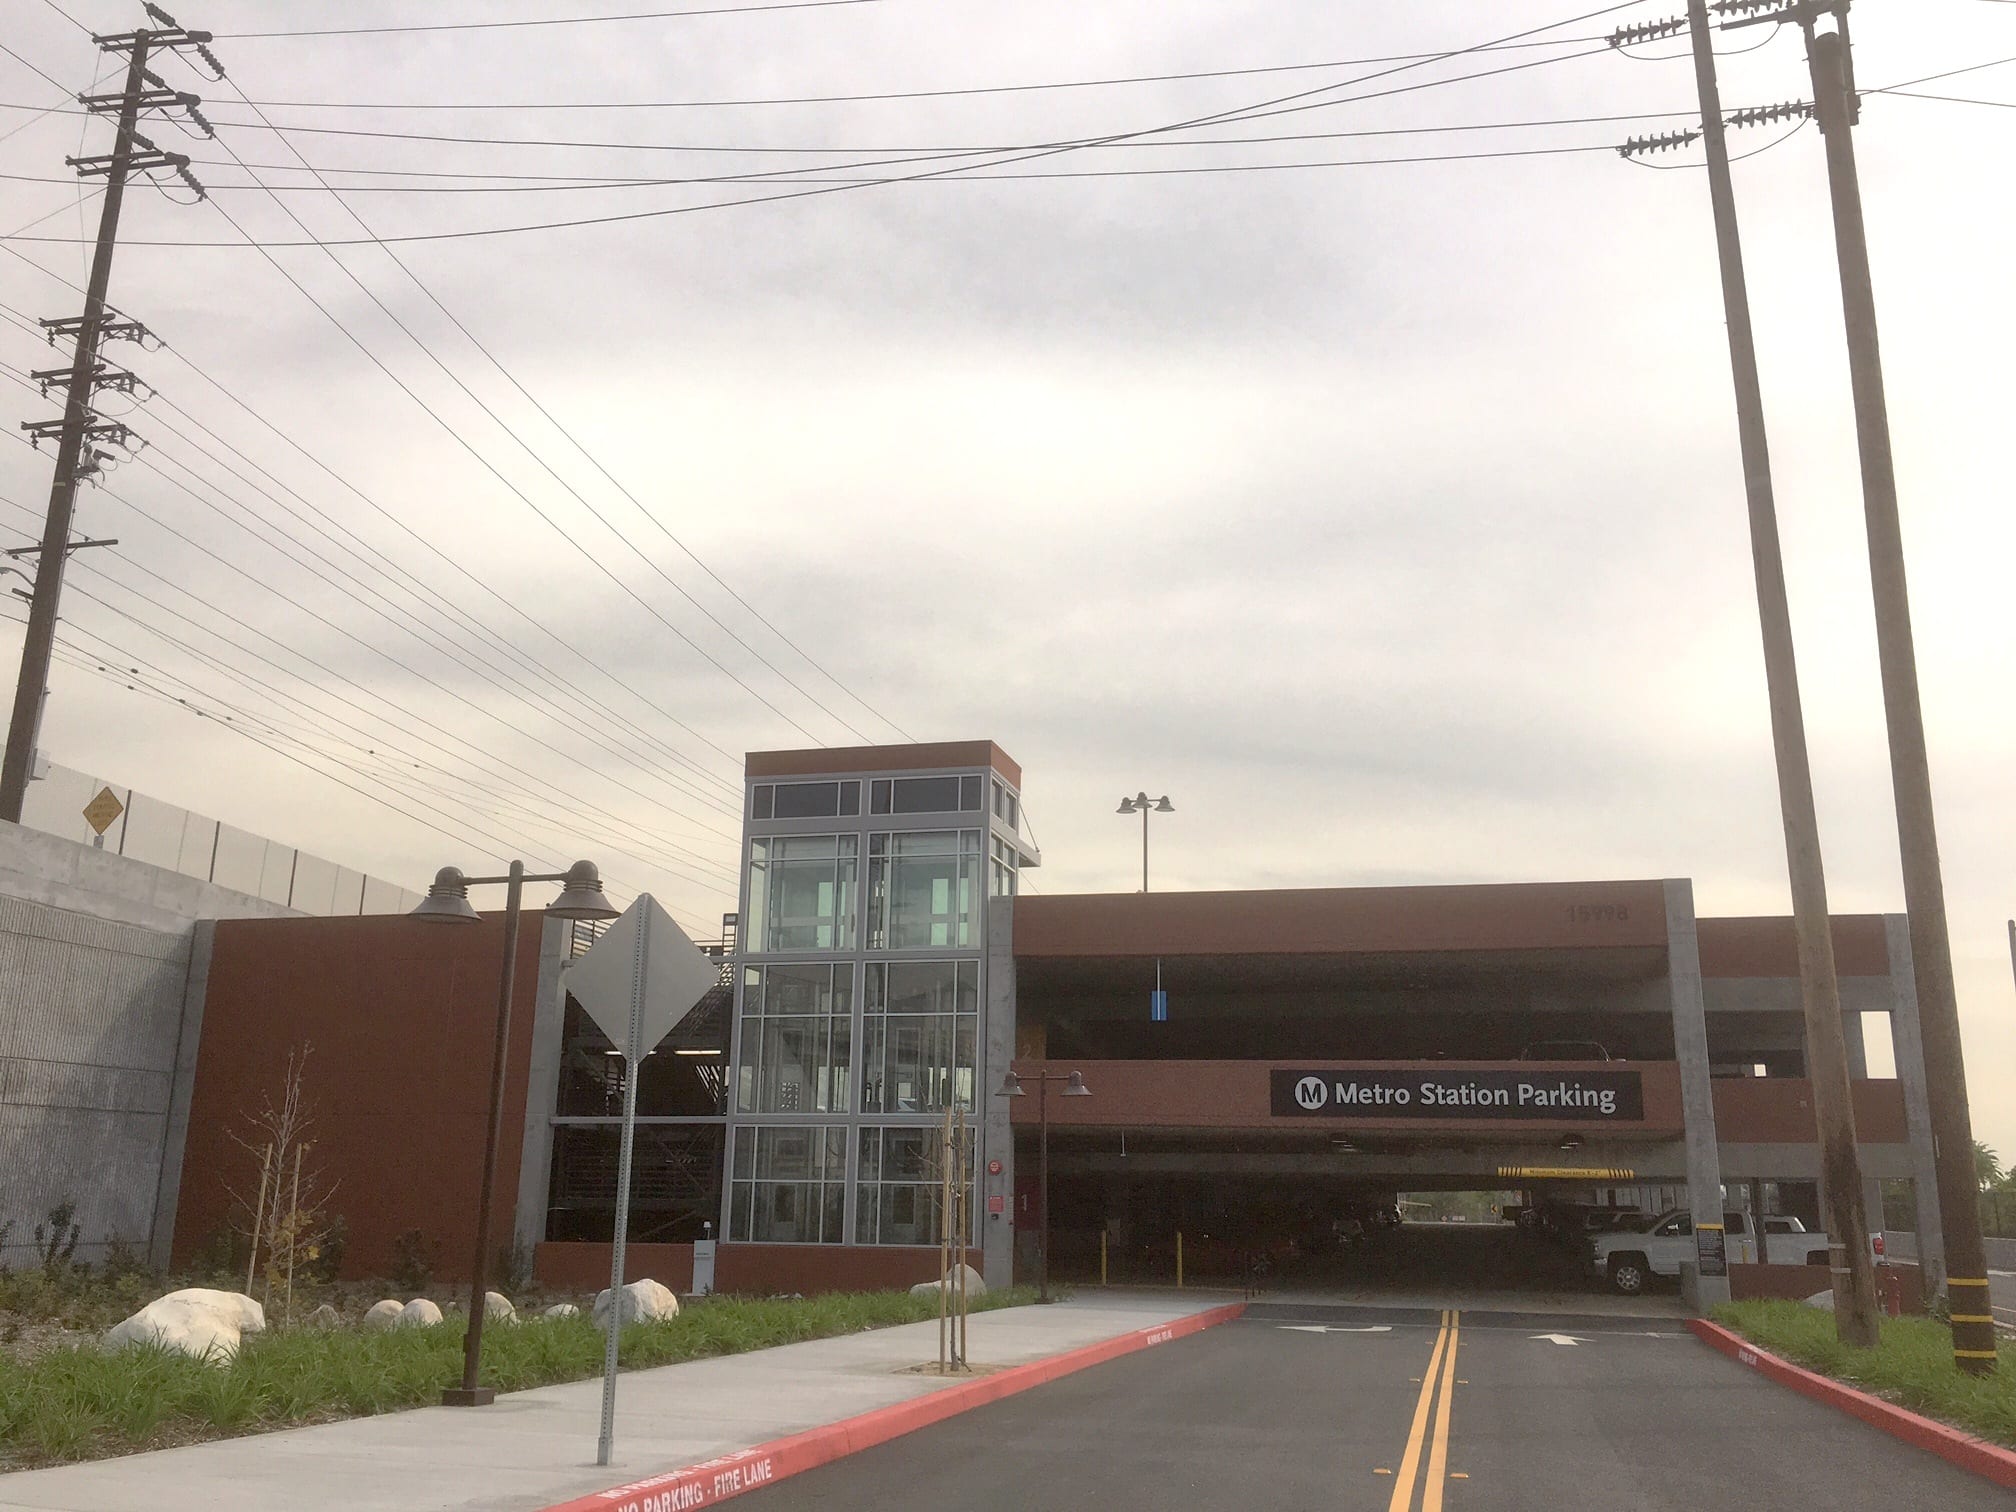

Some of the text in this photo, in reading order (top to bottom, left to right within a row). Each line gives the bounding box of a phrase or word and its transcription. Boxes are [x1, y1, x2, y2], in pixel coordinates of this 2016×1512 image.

[1335, 1082, 1411, 1105] Metro
[1420, 1082, 1509, 1106] Station
[1517, 1082, 1616, 1114] Parking
[643, 1481, 704, 1512] PARKING
[714, 1468, 741, 1497] FIRE
[743, 1458, 772, 1486] LANE
